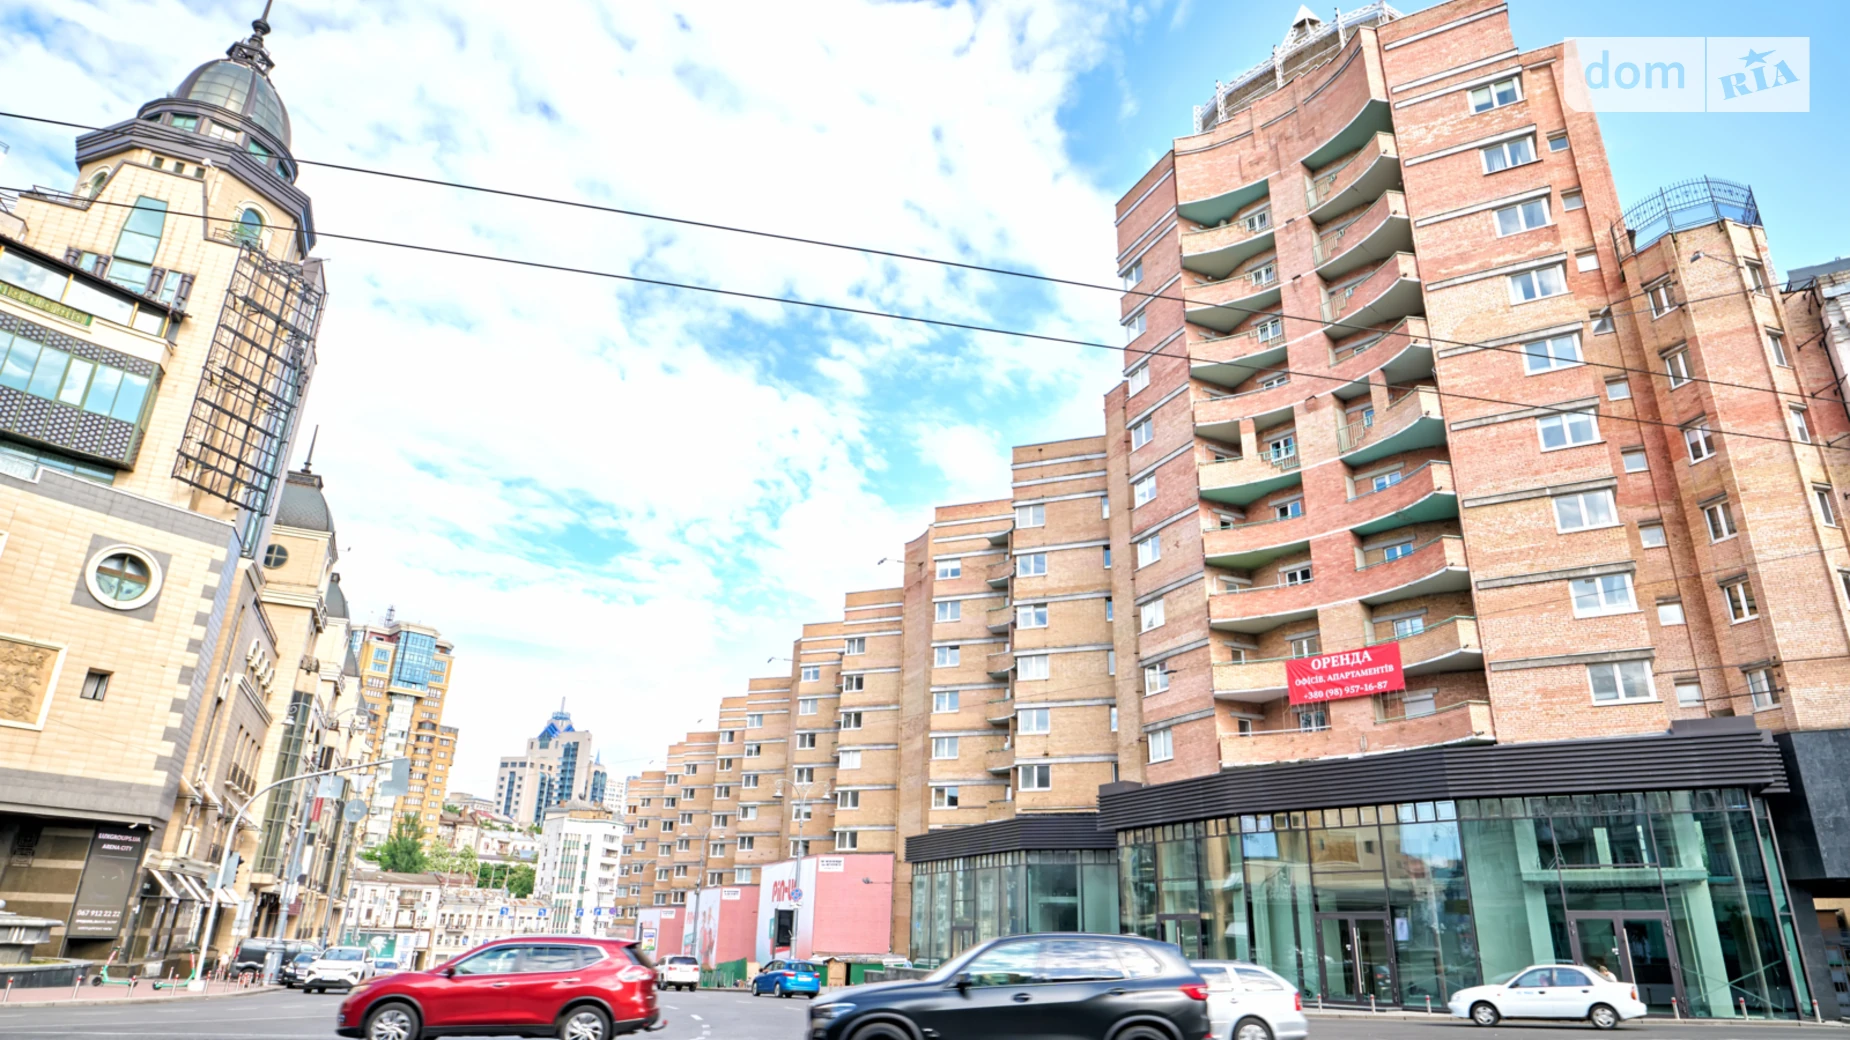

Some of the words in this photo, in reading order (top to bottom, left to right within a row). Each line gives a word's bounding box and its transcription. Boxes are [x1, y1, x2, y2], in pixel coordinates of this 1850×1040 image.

[1310, 650, 1373, 670] ОРЕНДА
[1303, 690, 1324, 700] +380
[1344, 680, 1389, 694] 957-16-87
